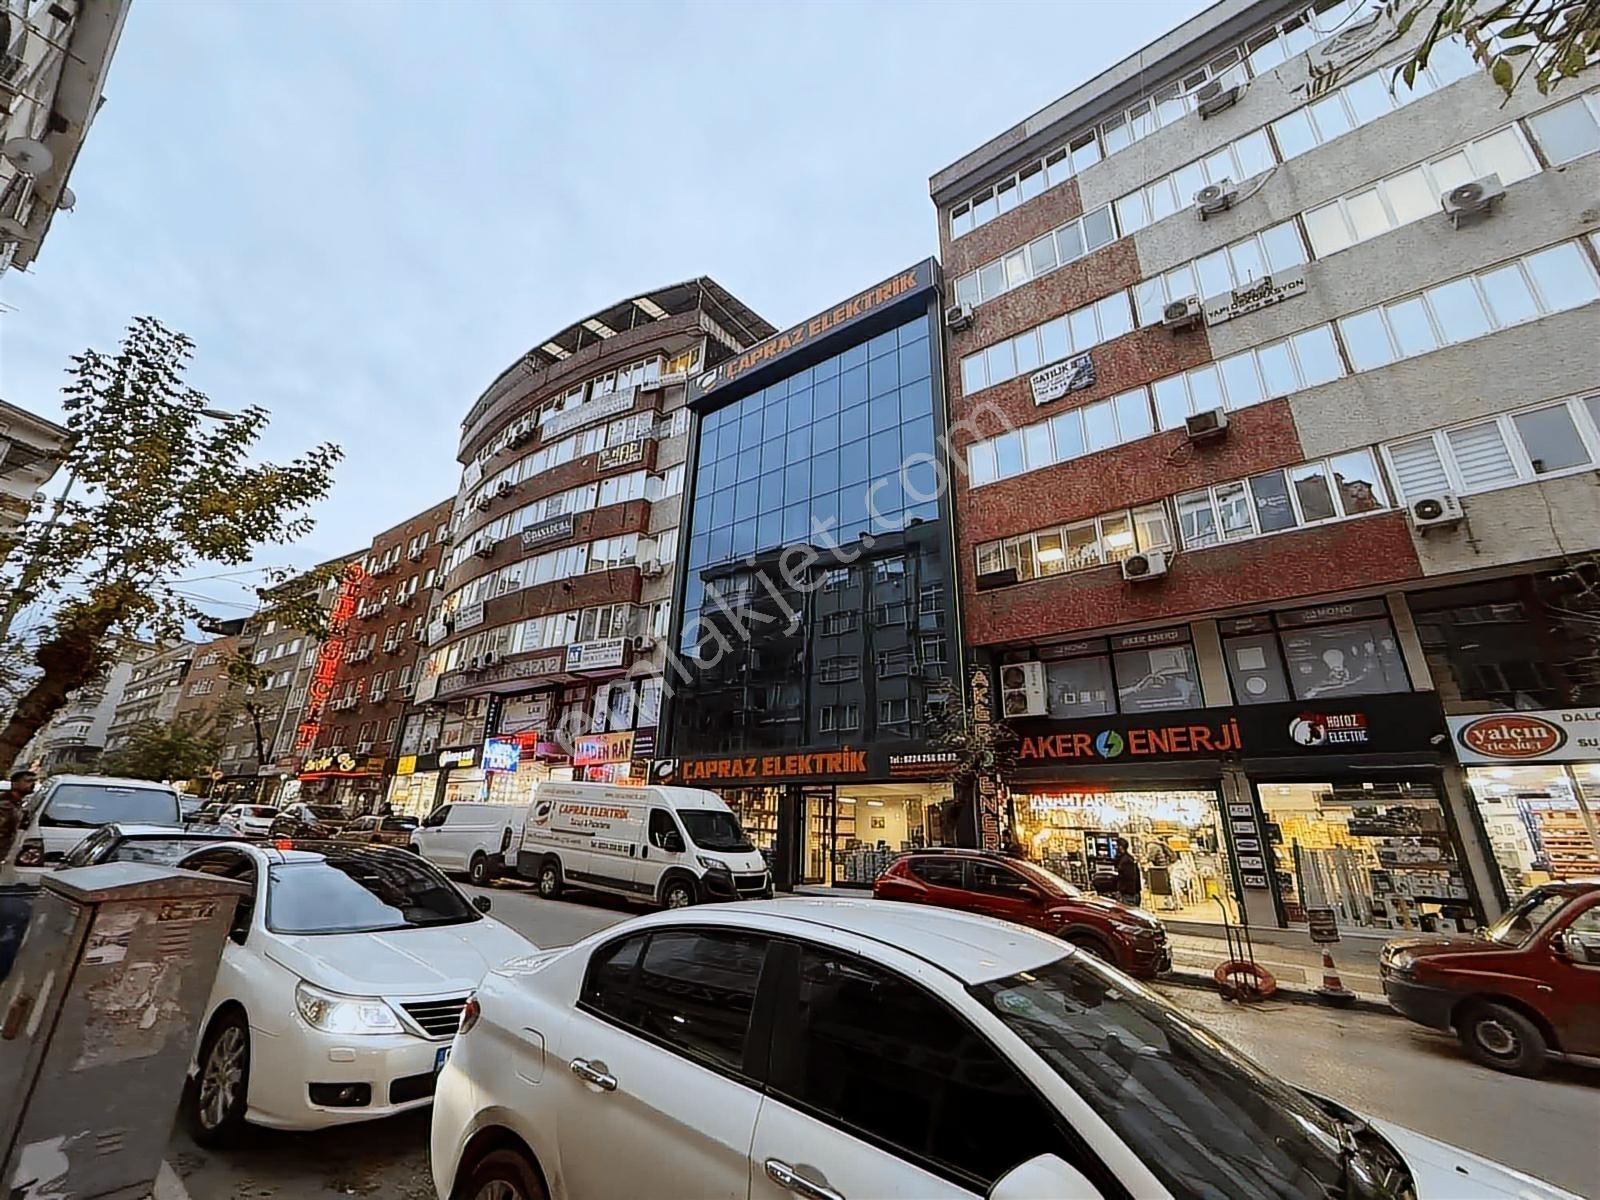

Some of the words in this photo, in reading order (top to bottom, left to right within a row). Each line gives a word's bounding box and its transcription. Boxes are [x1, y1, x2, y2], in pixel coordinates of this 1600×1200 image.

[726, 327, 804, 381] ÇAPRAZ
[808, 270, 918, 338] ELEKTRİK
[1018, 733, 1094, 760] AKER
[1128, 717, 1243, 756] ENERJİ
[1471, 725, 1549, 745] yalçın
[682, 758, 756, 785] ÇAPRAZ
[761, 745, 867, 776] ELEKTRİK
